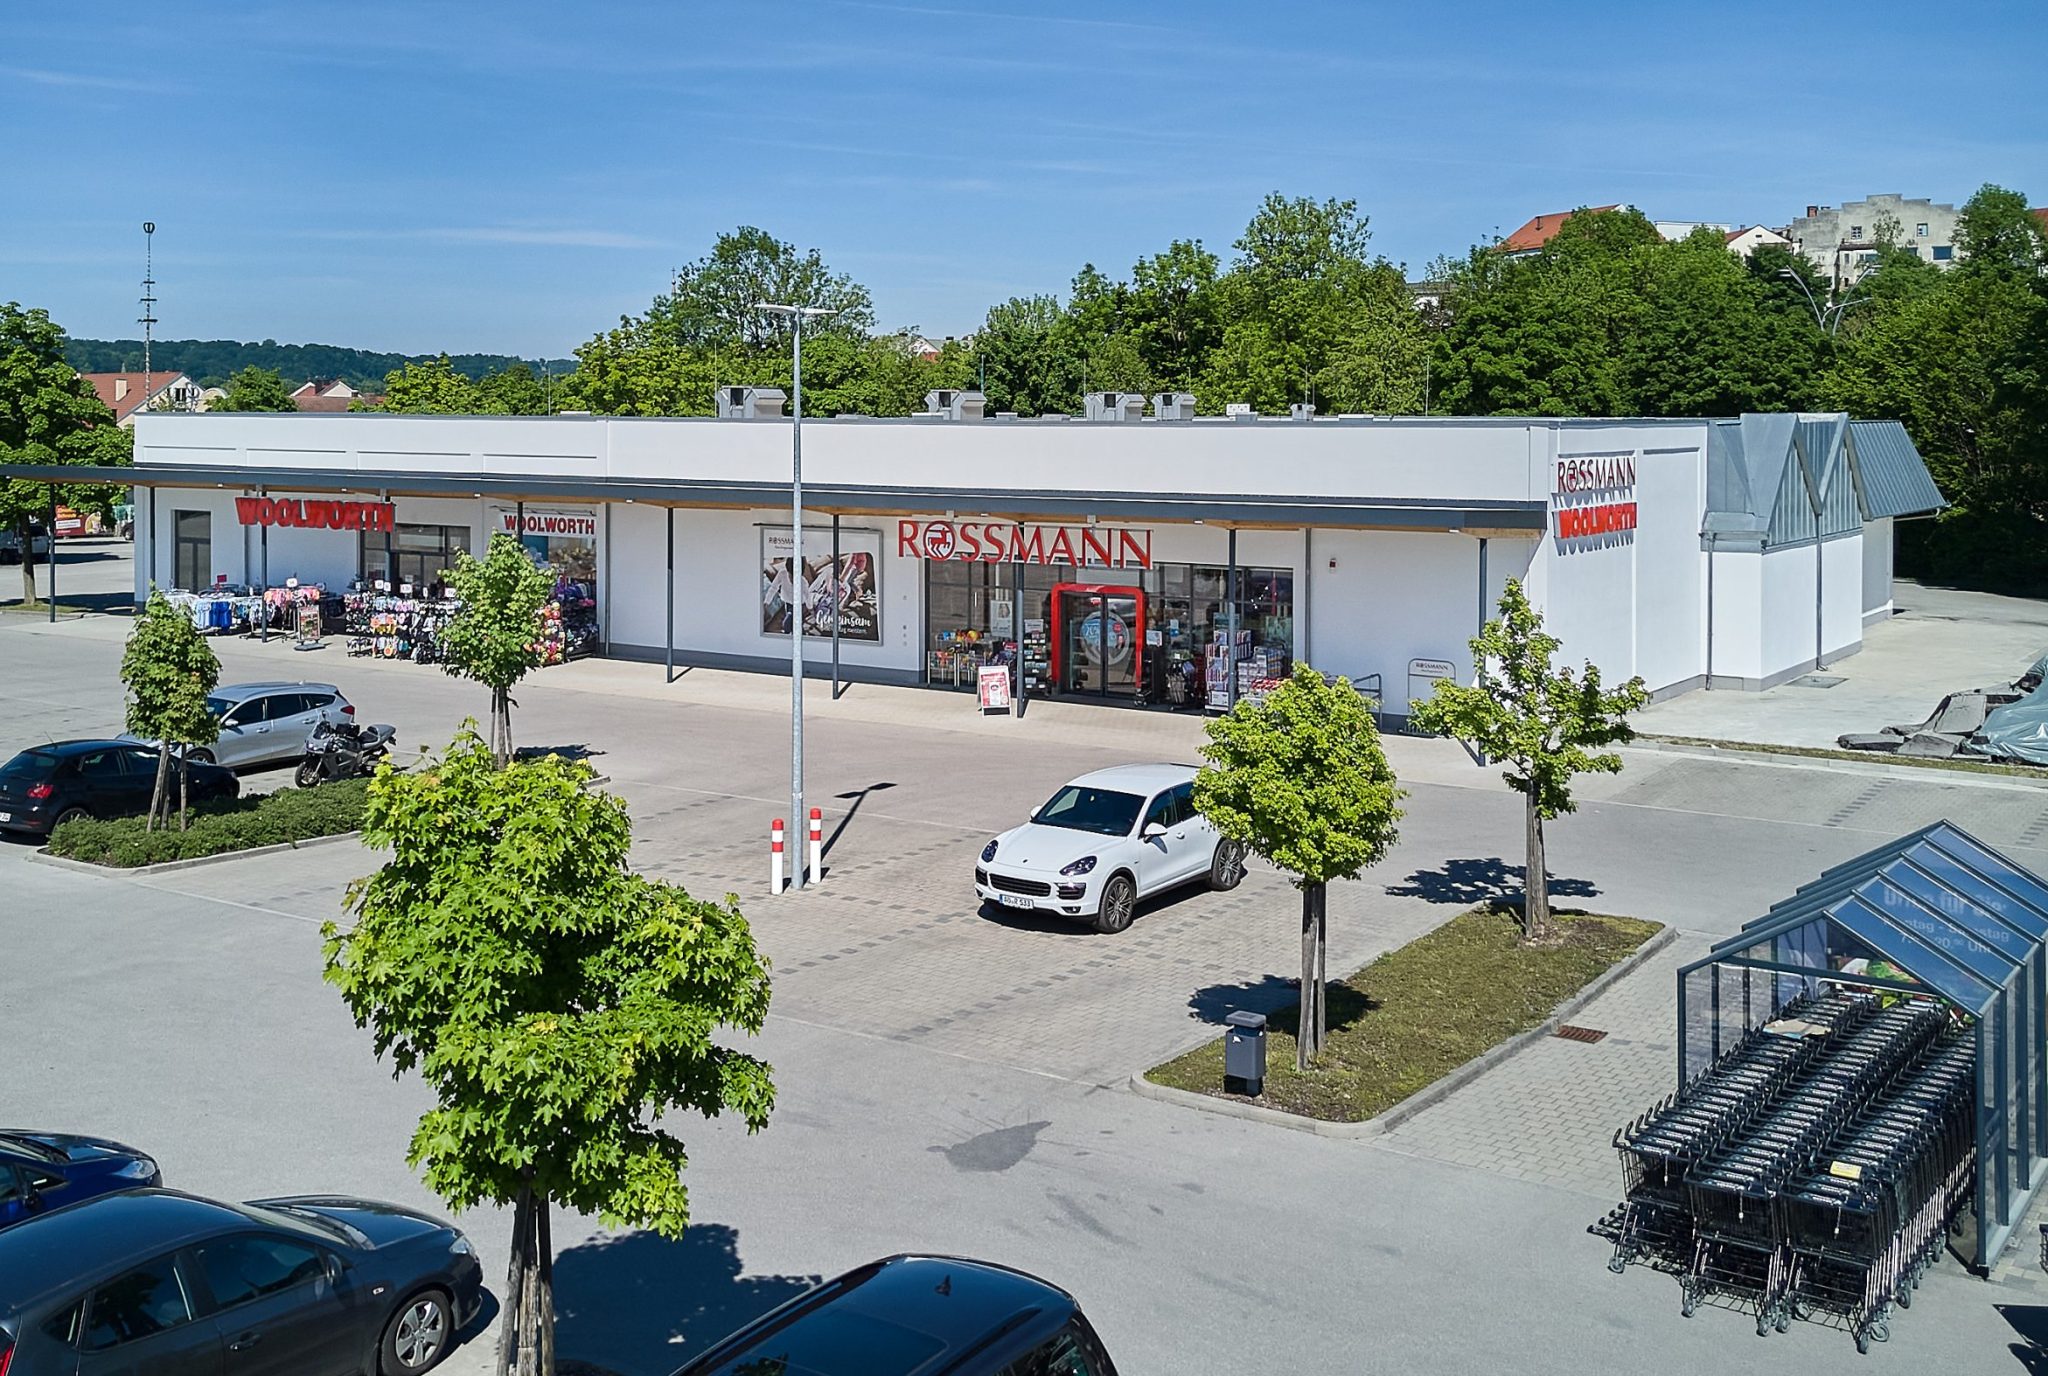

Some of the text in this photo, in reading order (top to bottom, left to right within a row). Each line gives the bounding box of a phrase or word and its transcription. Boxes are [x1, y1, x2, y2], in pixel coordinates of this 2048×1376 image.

[1558, 457, 1636, 493] ROSSMANN
[235, 497, 396, 532] WOOLWORTH
[1559, 502, 1637, 539] WOOLWORTH
[898, 520, 1152, 569] ROSSMANN
